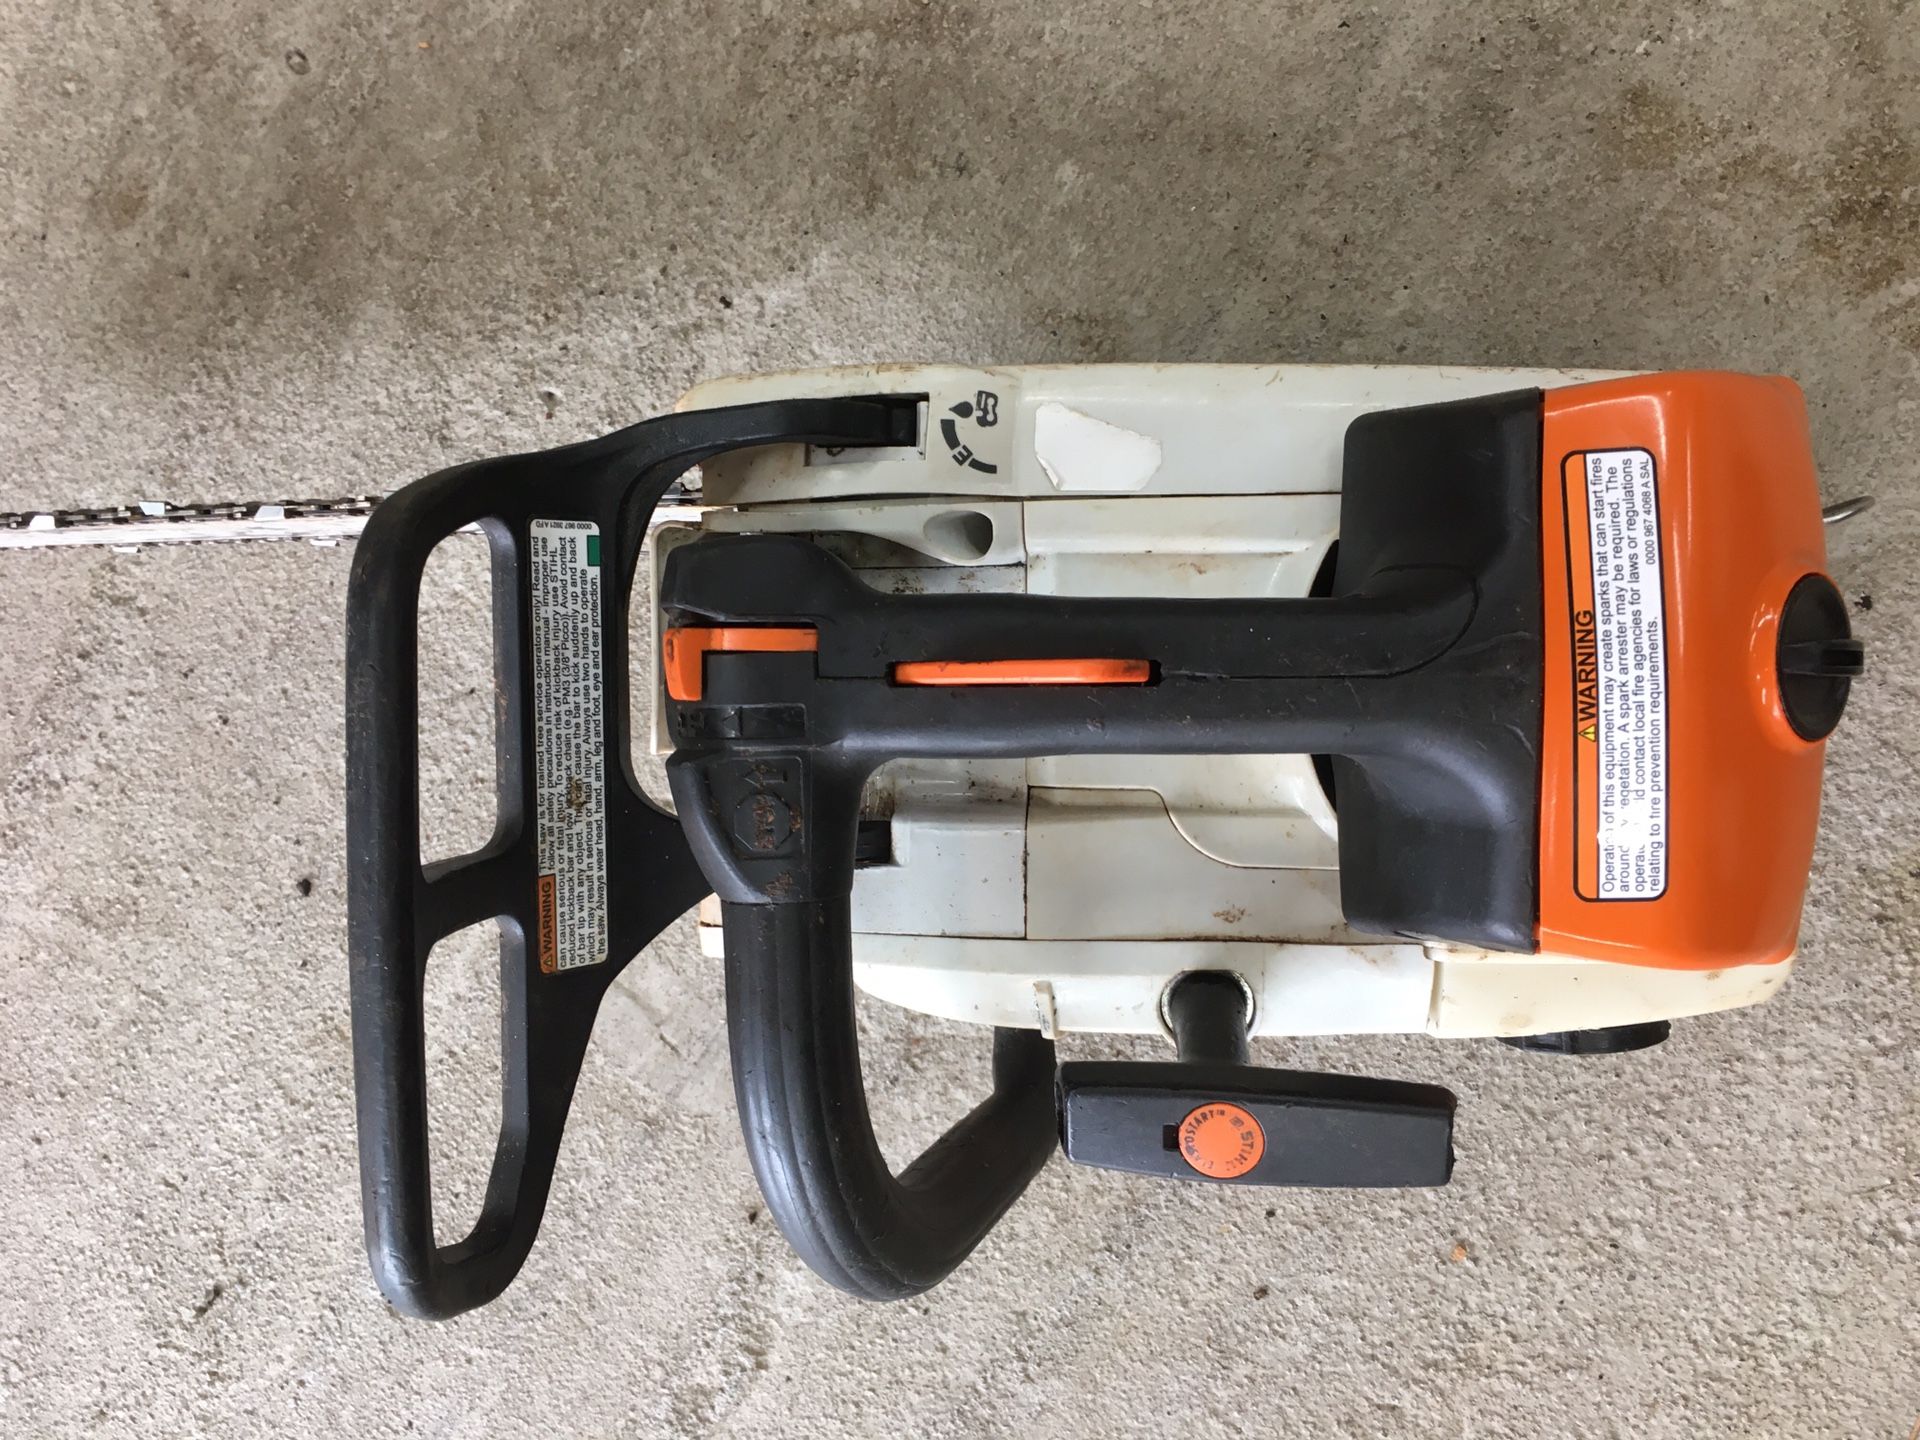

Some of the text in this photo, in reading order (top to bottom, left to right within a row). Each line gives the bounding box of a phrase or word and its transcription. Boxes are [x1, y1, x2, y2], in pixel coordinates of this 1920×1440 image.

[1590, 458, 1603, 485] fires
[1606, 467, 1617, 492] The
[1640, 458, 1650, 478] SAL
[1593, 490, 1605, 519] start
[1622, 458, 1638, 530] regulations
[1642, 491, 1652, 515] 4068
[1596, 523, 1606, 547] can
[1608, 498, 1624, 559] required.
[1644, 519, 1654, 537] 967
[568, 537, 576, 563] back
[1627, 535, 1637, 549] or
[1645, 540, 1656, 564] 0000
[549, 547, 557, 583] STIHL
[559, 537, 567, 576] contact
[1596, 551, 1608, 576] that
[1628, 553, 1639, 583] laws
[532, 561, 540, 591] Read
[541, 560, 550, 607] improper
[569, 567, 577, 588] and
[1612, 564, 1624, 581] be
[560, 579, 568, 609] Avoid
[571, 591, 578, 605] up
[579, 569, 590, 610] operate
[590, 575, 600, 627] protection.
[1615, 586, 1628, 615] may
[1628, 588, 1640, 605] for
[1598, 581, 1613, 625] sparks
[551, 610, 561, 640] injury
[580, 613, 588, 623] to
[542, 617, 550, 656] manual
[570, 608, 580, 658] suddenly
[580, 627, 589, 659] hands
[1630, 610, 1646, 670] agencies
[534, 626, 543, 679] operators
[591, 650, 600, 670] and
[1601, 630, 1613, 672] create
[1615, 620, 1628, 675] arrester
[552, 645, 561, 693] kickback
[571, 662, 579, 683] kick
[1575, 610, 1596, 722] WARNING
[543, 660, 552, 713] instruction
[562, 680, 571, 705] PM3
[572, 687, 579, 697] to
[593, 673, 602, 691] eye
[1604, 677, 1616, 704] may
[1632, 675, 1644, 696] fire
[535, 682, 543, 722] service
[553, 696, 561, 707] of
[572, 700, 580, 719] bar
[592, 694, 601, 716] foot,
[1617, 680, 1631, 718] spark
[544, 716, 552, 725] in
[553, 710, 561, 730] risk
[563, 707, 573, 730] (e.g.
[582, 707, 593, 744] Always
[592, 719, 600, 738] and
[1618, 723, 1629, 732] A
[1633, 701, 1645, 731] local
[563, 733, 571, 761] chain
[593, 741, 603, 757] leg
[1603, 709, 1617, 779] equipment
[1647, 617, 1663, 891] relating to fire prevention requirements.
[536, 751, 544, 789] trained
[545, 728, 554, 788] precautions
[584, 748, 594, 778] injury.
[595, 759, 603, 782] arm,
[1634, 736, 1645, 784] contact
[554, 775, 563, 788] To
[1619, 738, 1634, 809] egetation.
[563, 765, 572, 809] kickback
[574, 778, 582, 799] can
[584, 781, 592, 803] fatal
[593, 785, 604, 813] hand,
[1602, 784, 1614, 807] this
[538, 810, 545, 819] is
[546, 792, 555, 822] safety
[574, 802, 583, 825] This
[585, 806, 593, 817] or
[1603, 811, 1614, 823] of
[565, 812, 573, 830] low
[594, 816, 604, 845] head,
[556, 826, 564, 850] fatal
[575, 828, 585, 864] object.
[585, 820, 593, 859] serious
[538, 848, 546, 872] This
[558, 854, 564, 864] or
[566, 856, 574, 872] bar
[585, 862, 594, 871] in
[557, 867, 566, 908] serious
[577, 868, 586, 887] any
[585, 874, 594, 903] result
[566, 877, 575, 920] kickback
[576, 891, 585, 913] with
[596, 875, 607, 910] Always
[542, 881, 552, 953] WARNING
[576, 916, 587, 930] tip
[587, 907, 598, 928] may
[567, 924, 576, 965] reduced
[577, 933, 585, 950] bar
[587, 932, 595, 962] which
[597, 937, 605, 954] the
[578, 953, 585, 964] of
